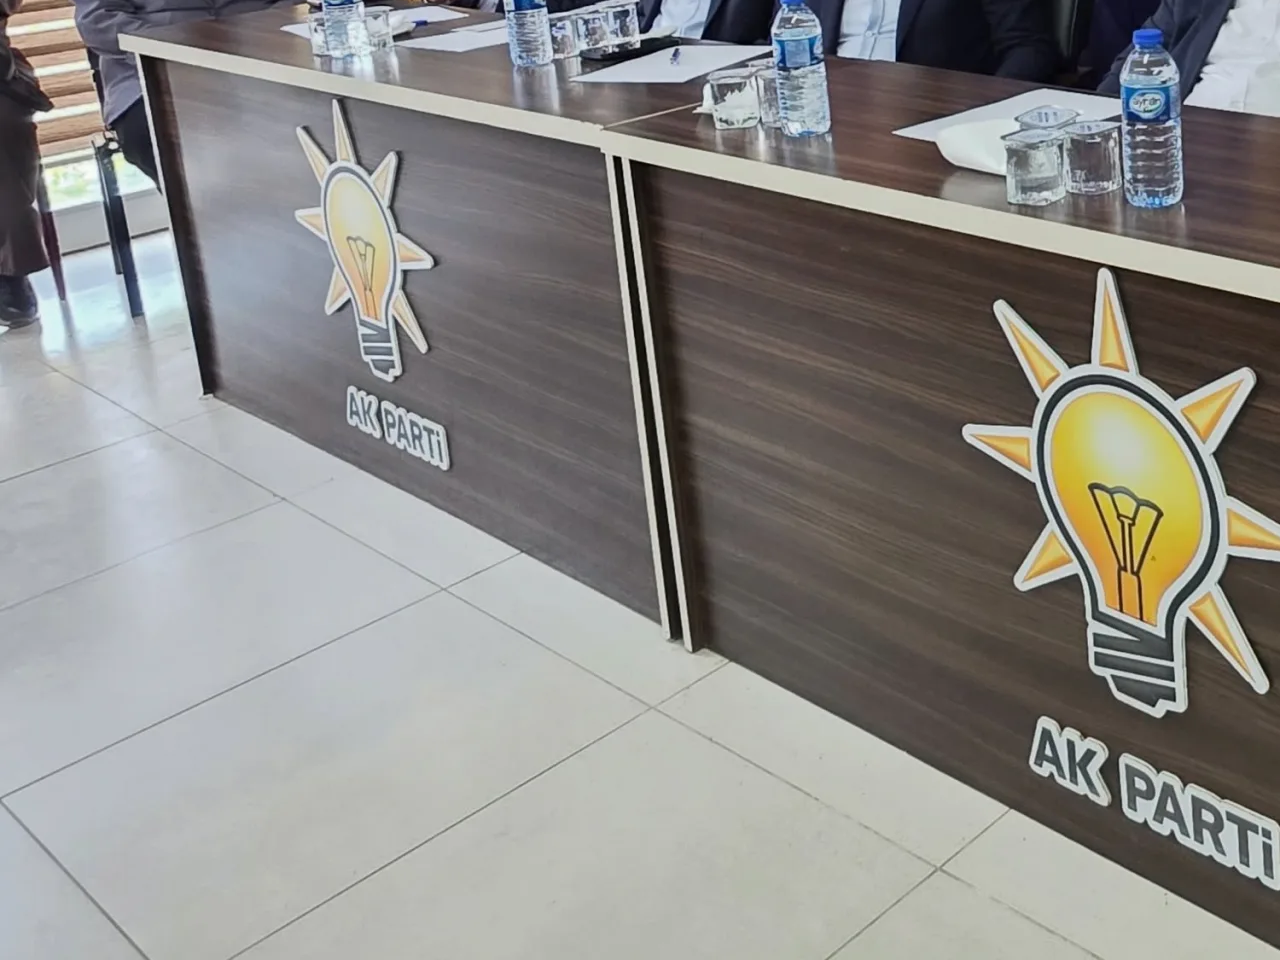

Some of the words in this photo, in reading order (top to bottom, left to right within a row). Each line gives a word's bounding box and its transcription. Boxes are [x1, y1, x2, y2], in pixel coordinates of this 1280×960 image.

[349, 391, 378, 433] AK
[383, 407, 444, 464] PARTİ
[1033, 725, 1101, 798] AK
[1122, 761, 1275, 881] PARTİ
